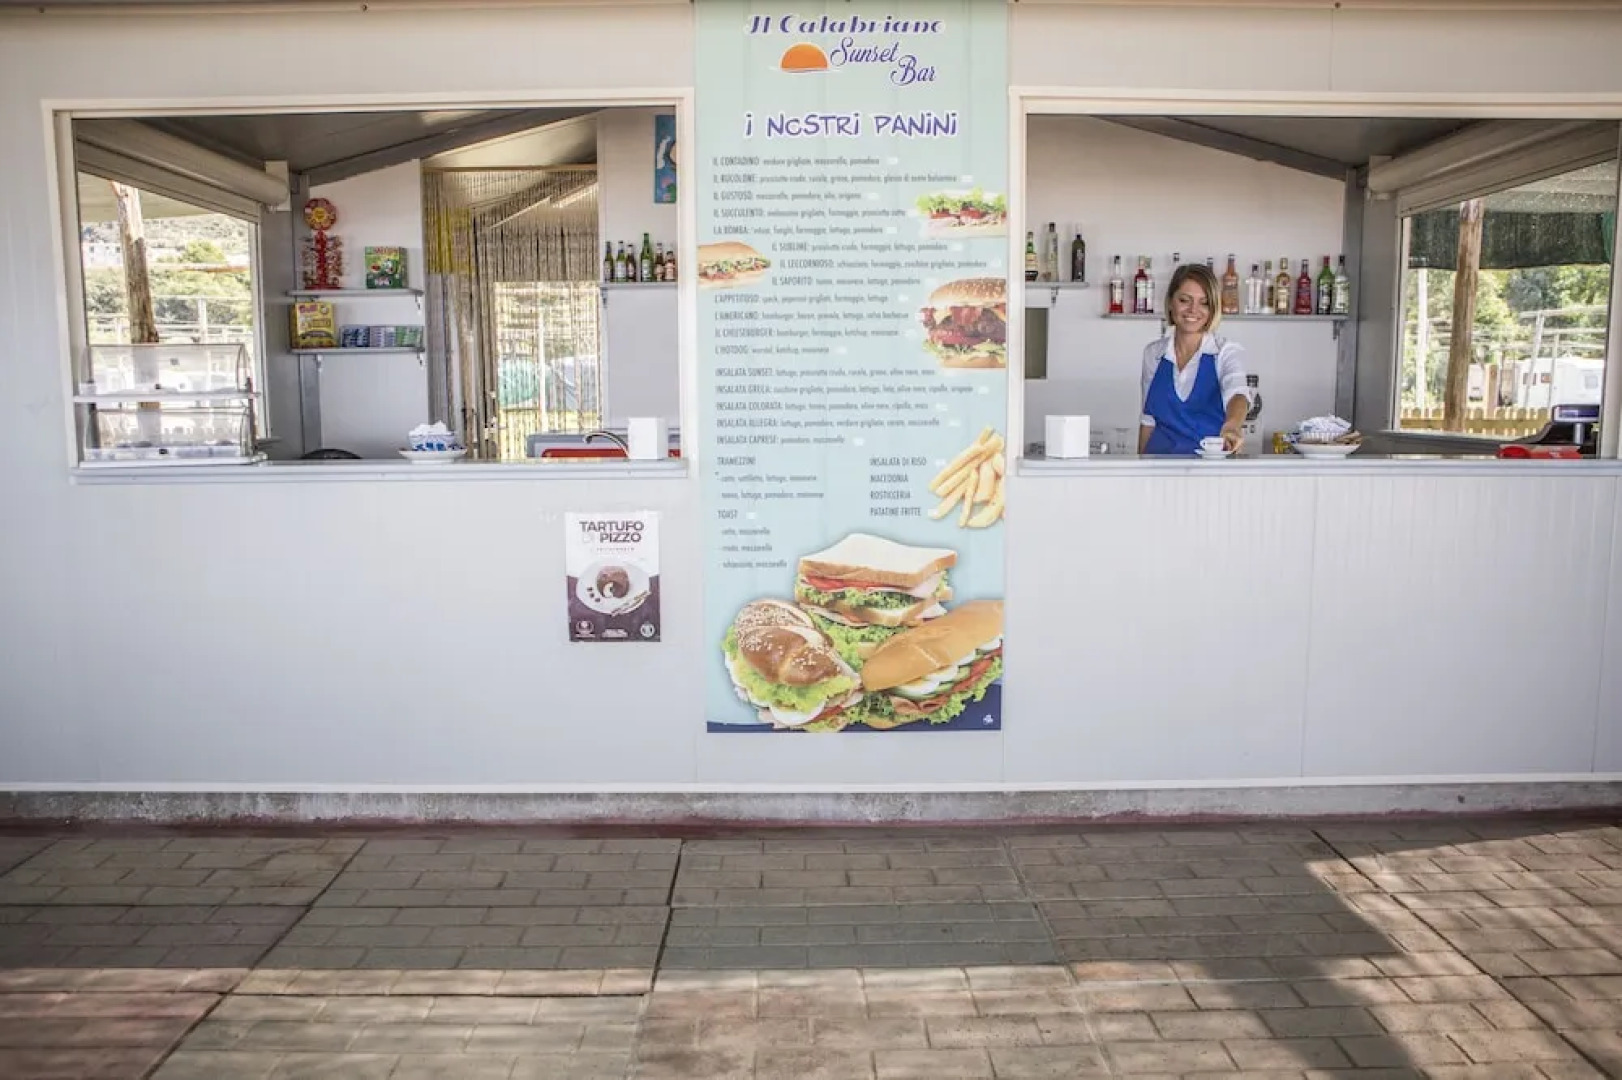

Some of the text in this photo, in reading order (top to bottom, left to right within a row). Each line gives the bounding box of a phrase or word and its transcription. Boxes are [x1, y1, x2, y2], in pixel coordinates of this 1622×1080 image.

[830, 37, 900, 67] Sunset
[890, 55, 936, 86] Bar
[579, 520, 645, 532] TARTUFO
[599, 532, 642, 544] PIZZO
